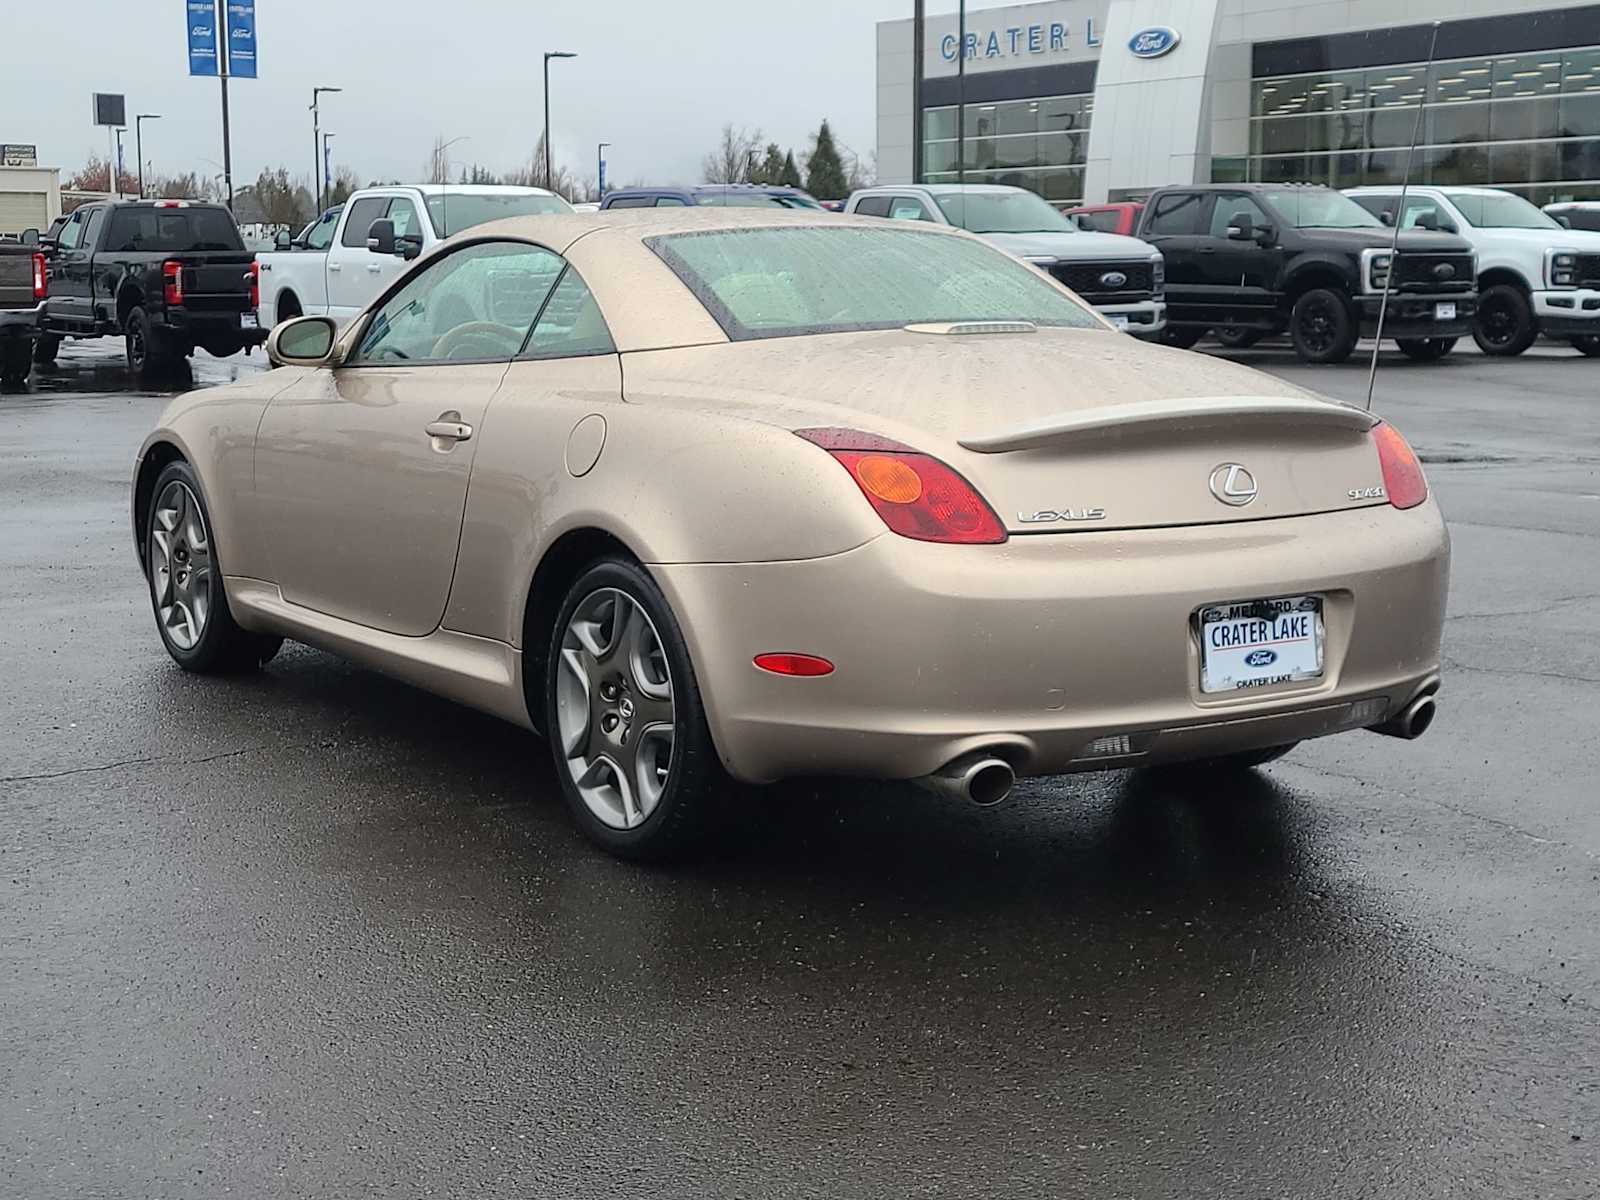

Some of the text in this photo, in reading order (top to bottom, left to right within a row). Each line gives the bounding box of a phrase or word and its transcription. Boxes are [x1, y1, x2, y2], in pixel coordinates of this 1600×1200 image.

[942, 23, 1067, 60] CRATER
[1135, 31, 1166, 51] Ford
[1017, 508, 1106, 523] LEXUS
[1212, 616, 1308, 647] CRATER LAKE
[1249, 650, 1274, 665] Ford
[1236, 674, 1292, 689] CRATER LAKE
